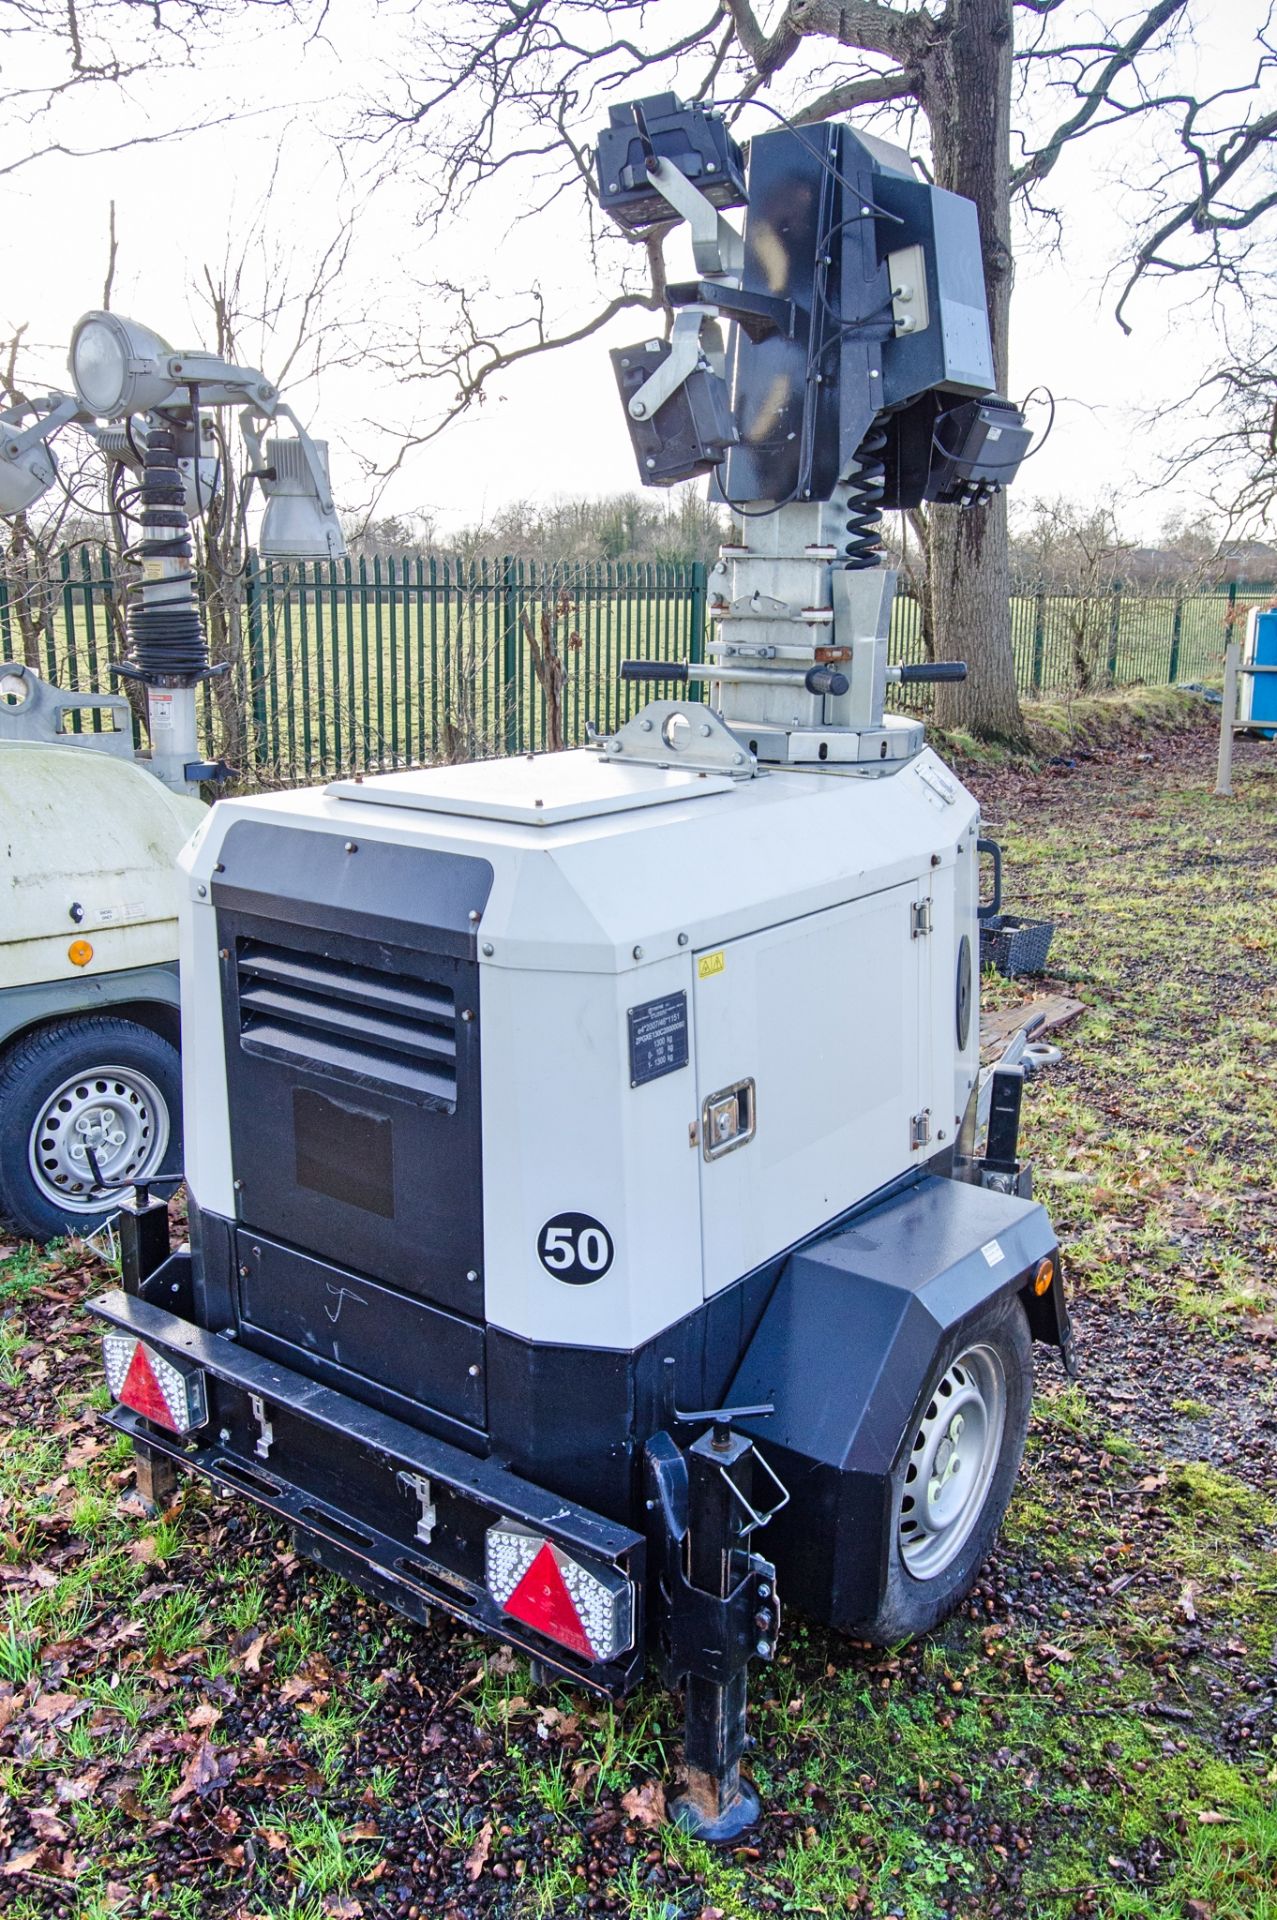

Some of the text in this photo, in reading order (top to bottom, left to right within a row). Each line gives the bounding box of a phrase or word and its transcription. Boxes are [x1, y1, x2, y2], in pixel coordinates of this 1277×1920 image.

[653, 1037, 666, 1048] 1300
[654, 1056, 666, 1066] 1300
[544, 1227, 608, 1271] 50
